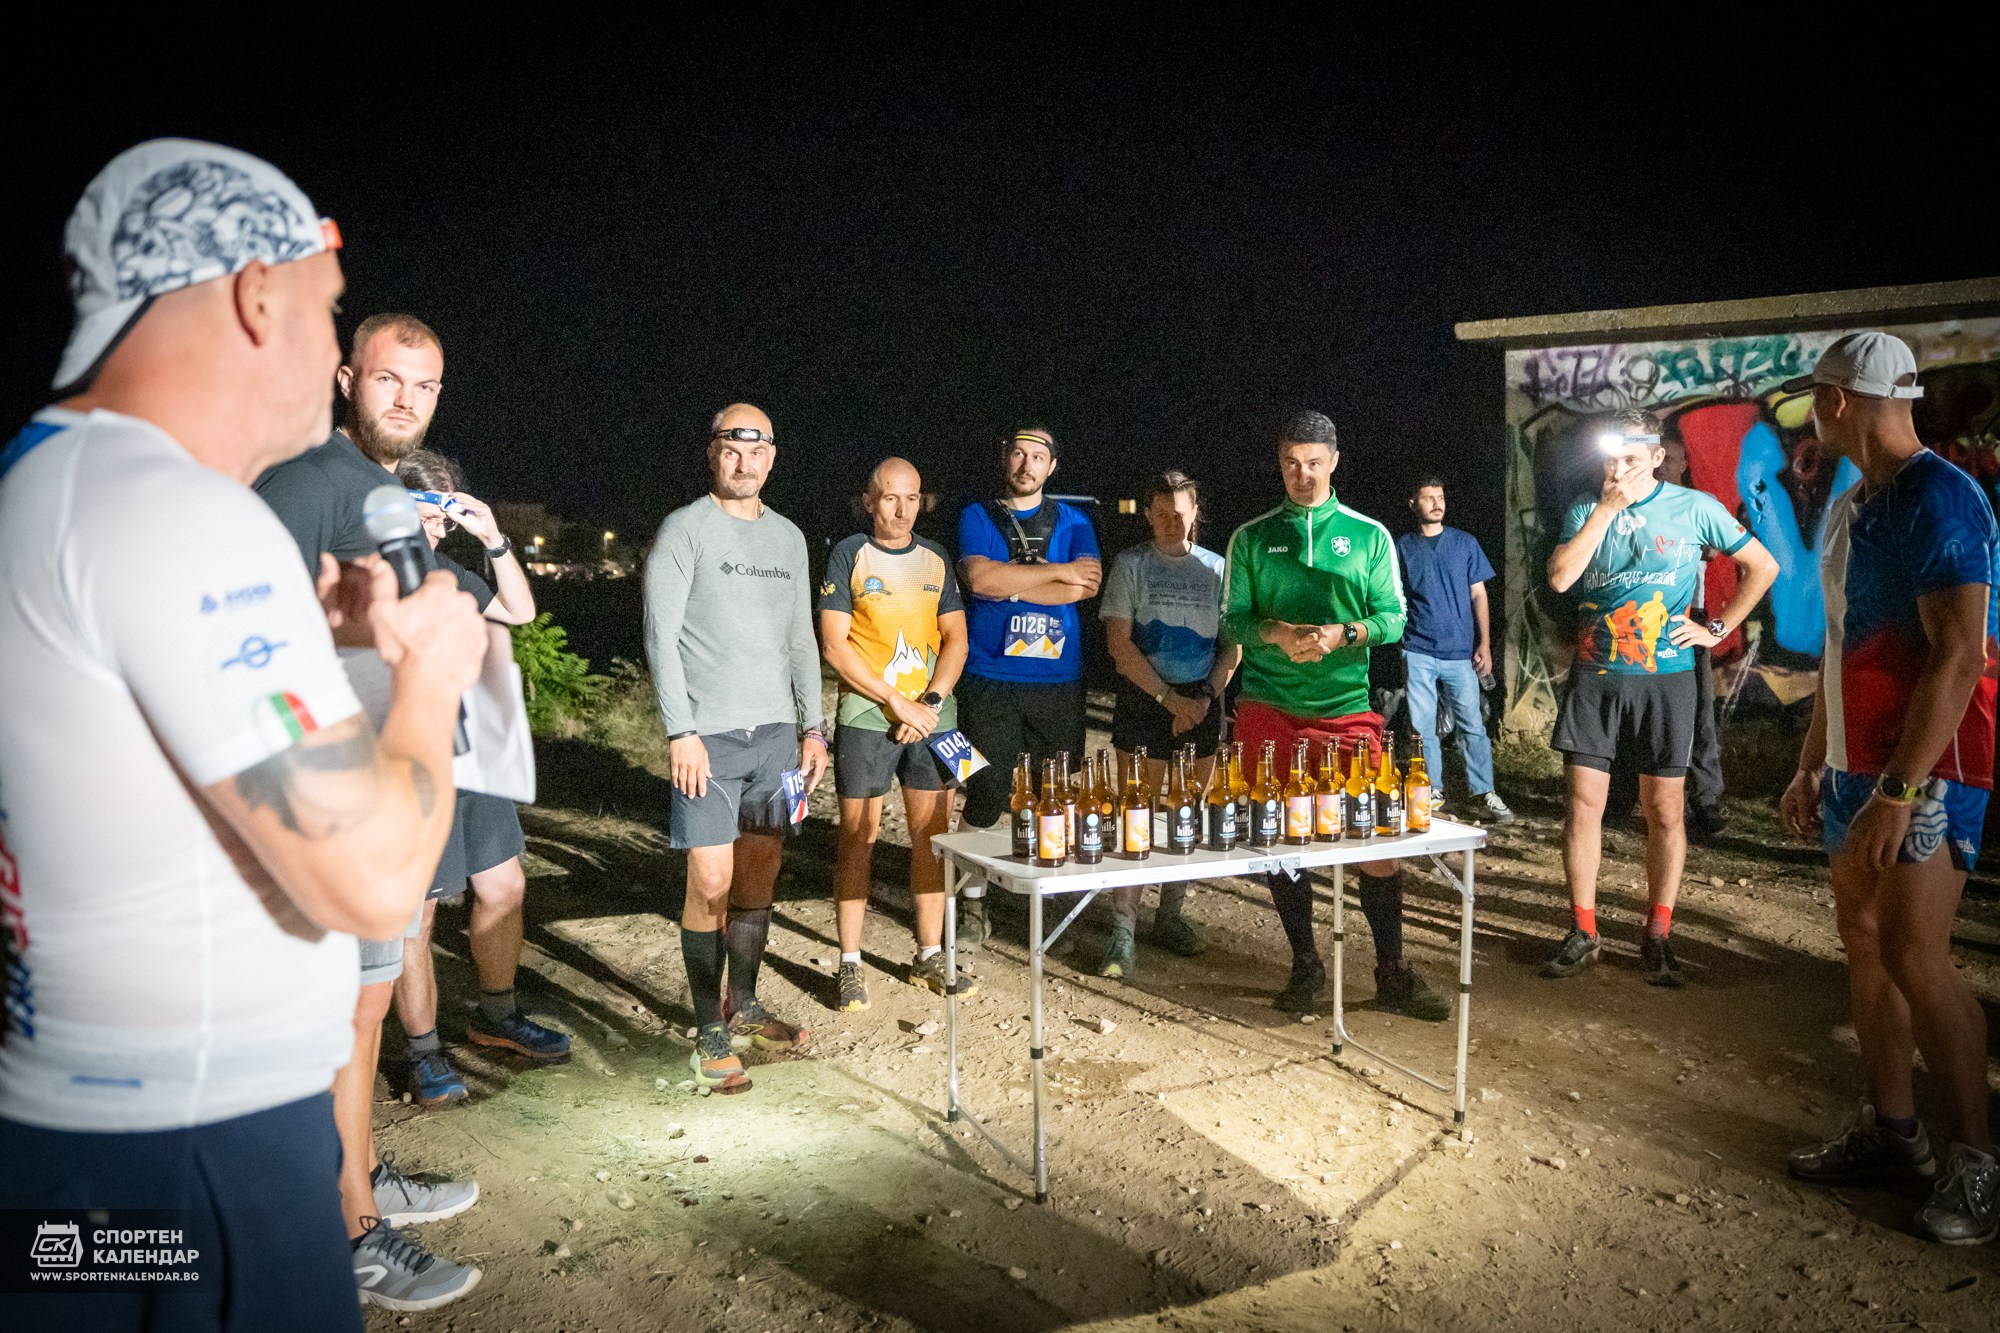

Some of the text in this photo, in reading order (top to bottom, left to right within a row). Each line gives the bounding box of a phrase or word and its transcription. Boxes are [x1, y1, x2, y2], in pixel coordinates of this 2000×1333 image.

[1268, 545, 1289, 554] JAKO
[735, 563, 791, 580] Columbia
[1010, 615, 1047, 635] 0126
[937, 731, 971, 759] 0142
[1355, 809, 1371, 821] hills
[1016, 826, 1035, 839] hills
[1176, 824, 1194, 837] hills
[1083, 832, 1101, 845] hills
